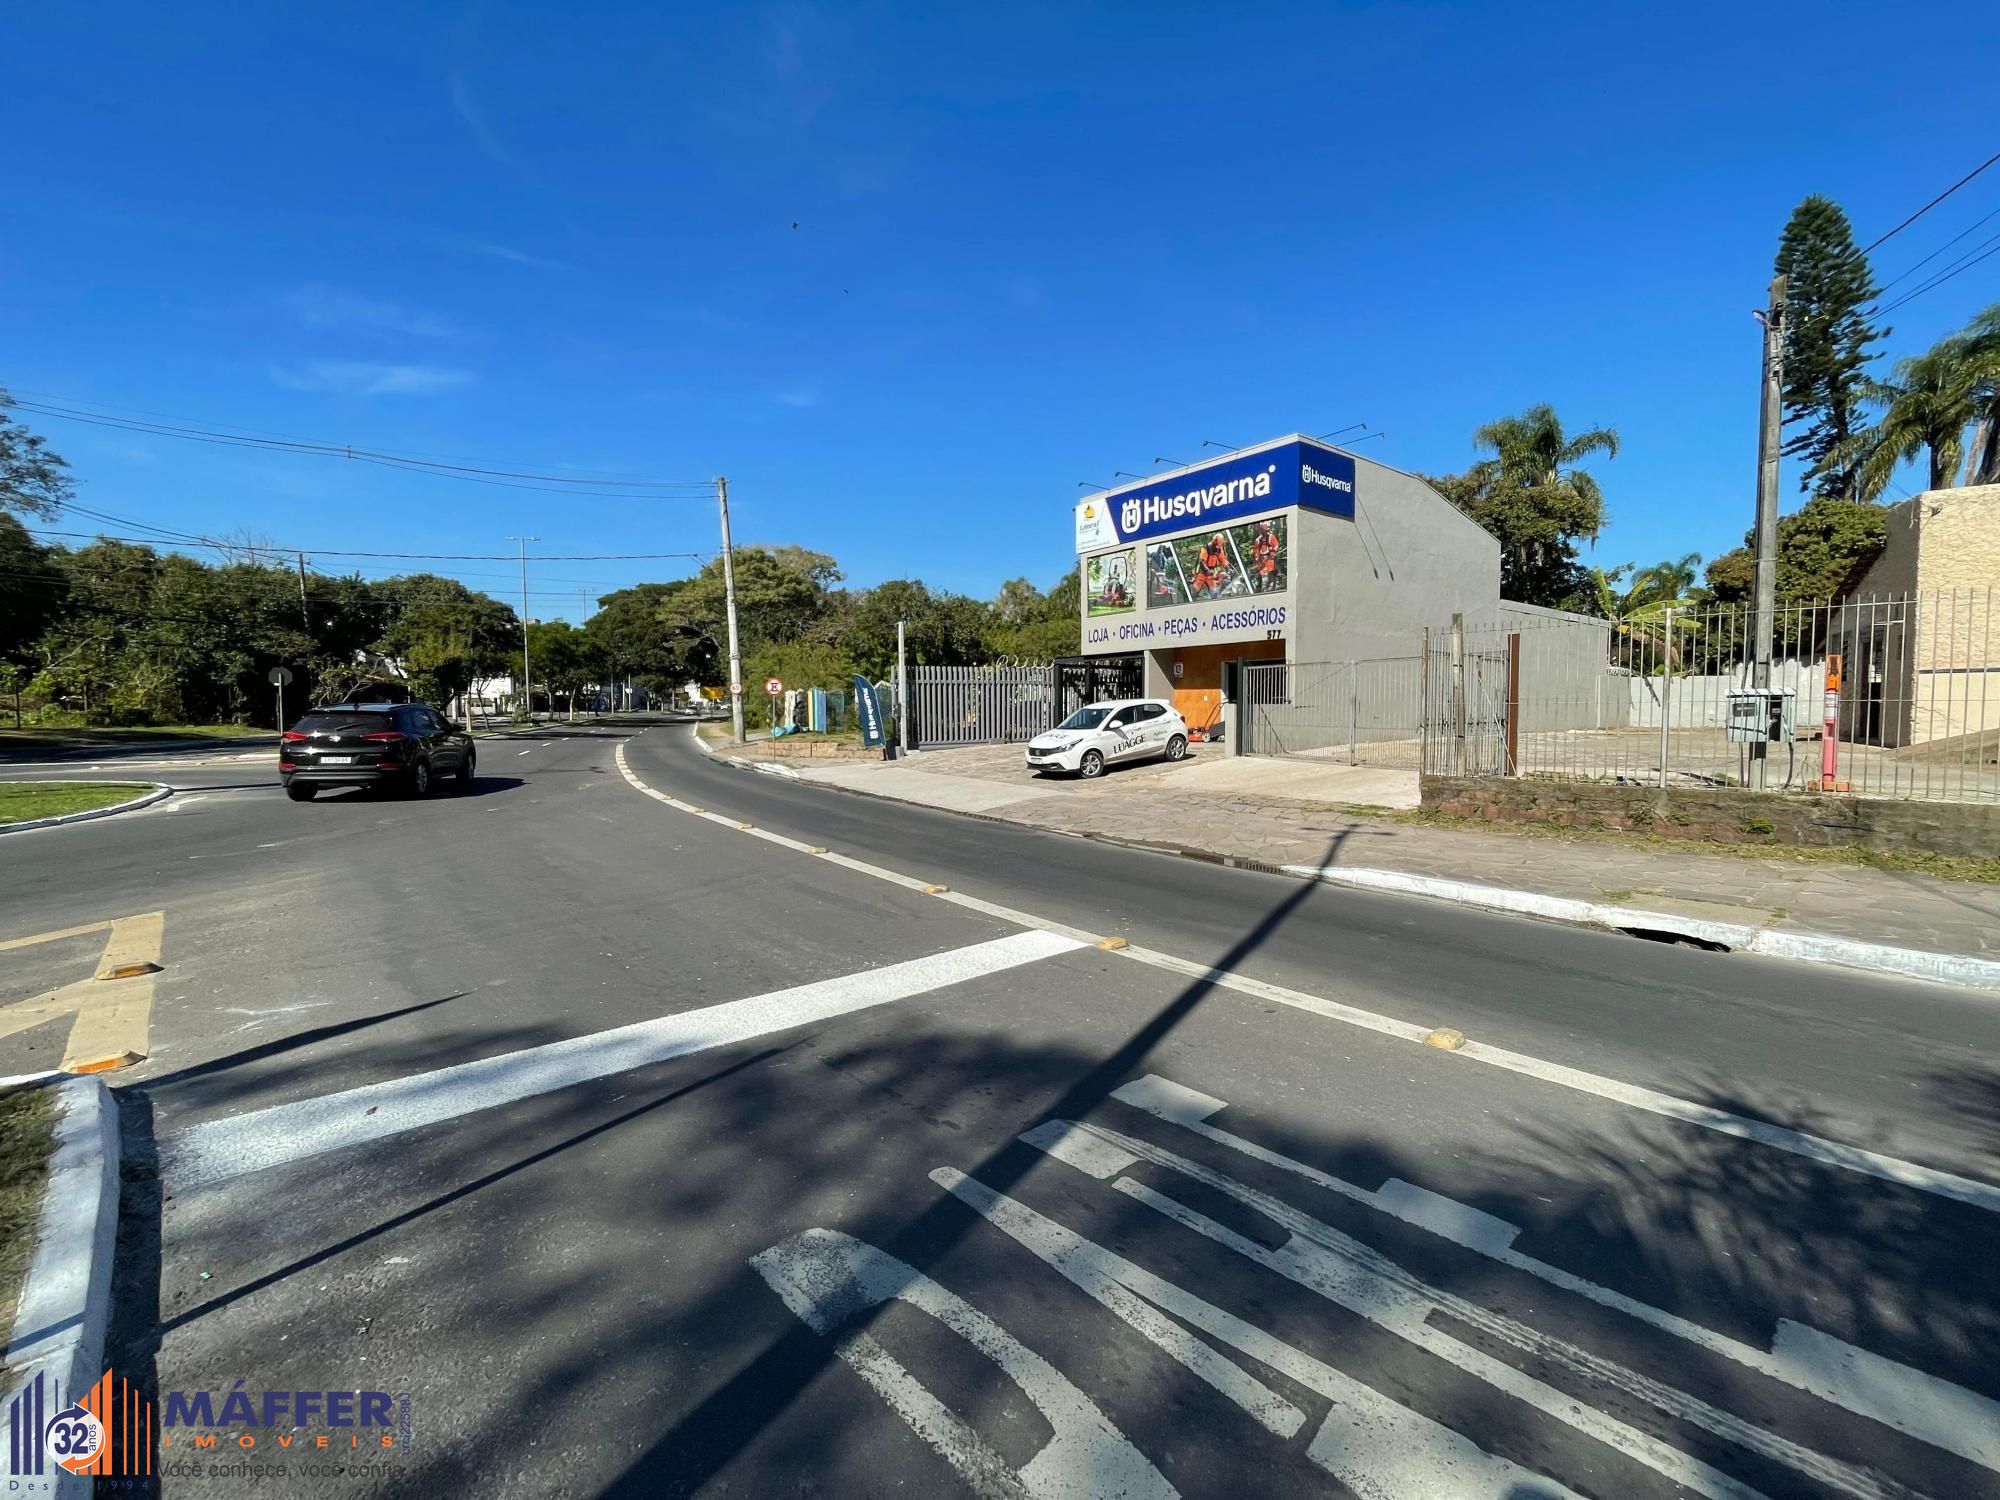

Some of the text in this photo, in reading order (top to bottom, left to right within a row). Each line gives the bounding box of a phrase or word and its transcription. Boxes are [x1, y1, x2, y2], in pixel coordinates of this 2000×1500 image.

[1311, 468, 1351, 493] Husqvarna
[1143, 472, 1270, 525] Husqvarna
[1088, 605, 1286, 643] LOJA OFICINA PEÇAS ACESSÓRIOS
[1266, 629, 1282, 640] 577
